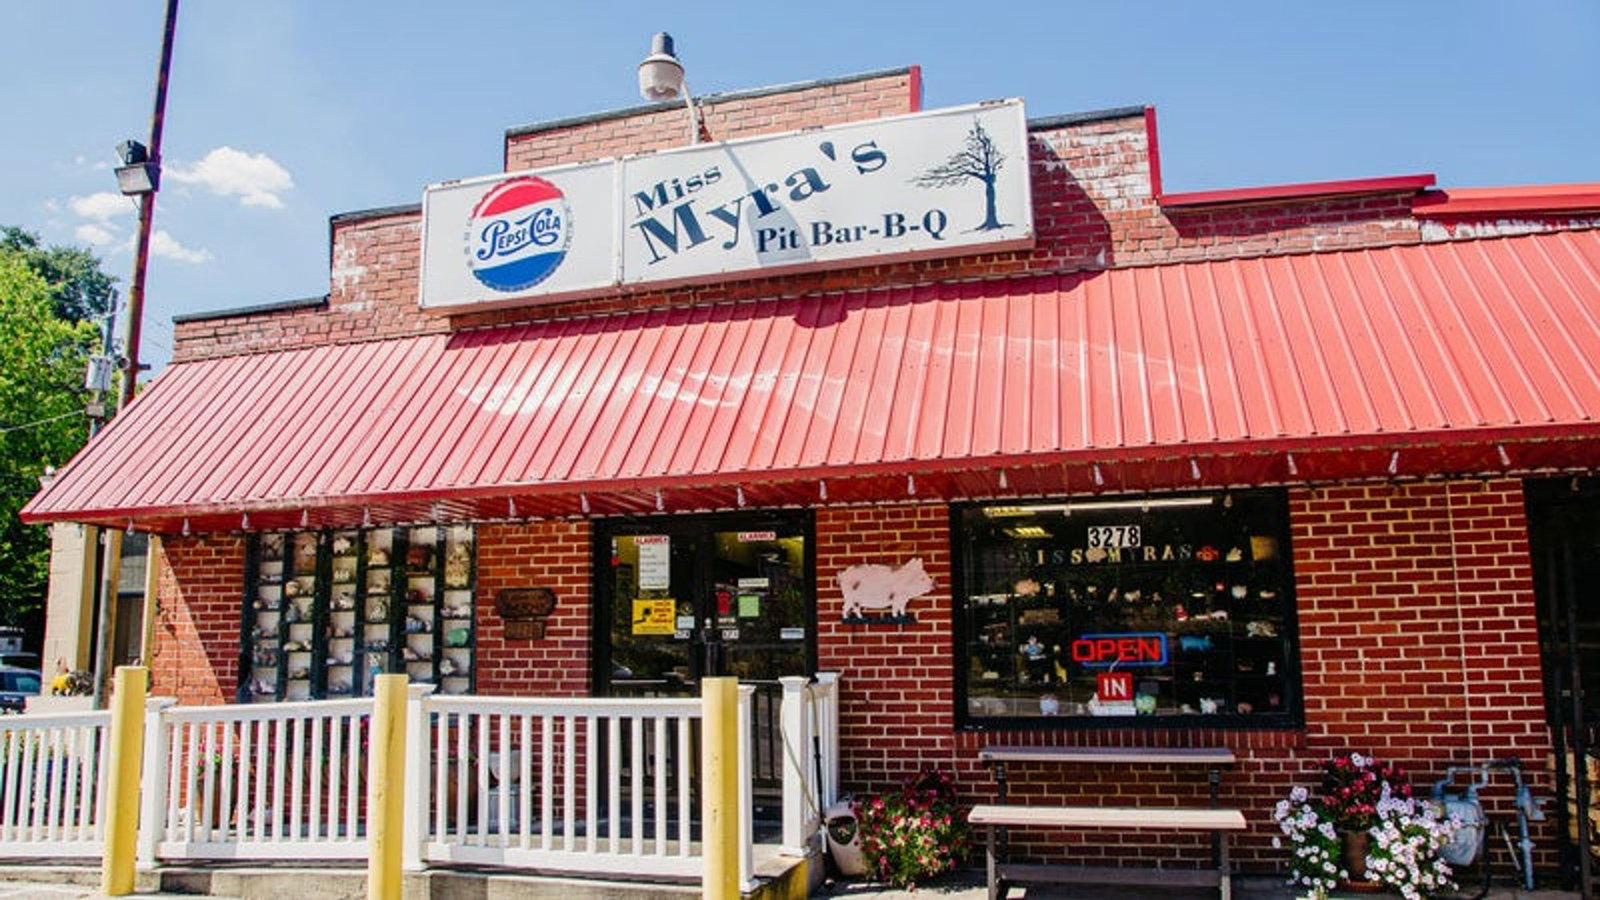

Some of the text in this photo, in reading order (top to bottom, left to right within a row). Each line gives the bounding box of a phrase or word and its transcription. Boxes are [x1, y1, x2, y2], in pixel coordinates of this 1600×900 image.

[630, 140, 887, 265] Myra's
[631, 166, 722, 218] Miss
[757, 209, 947, 253] Pit Bar-B-Q
[1089, 526, 1140, 548] 3278
[1072, 639, 1161, 662] OPEN
[1104, 677, 1126, 697] IN
